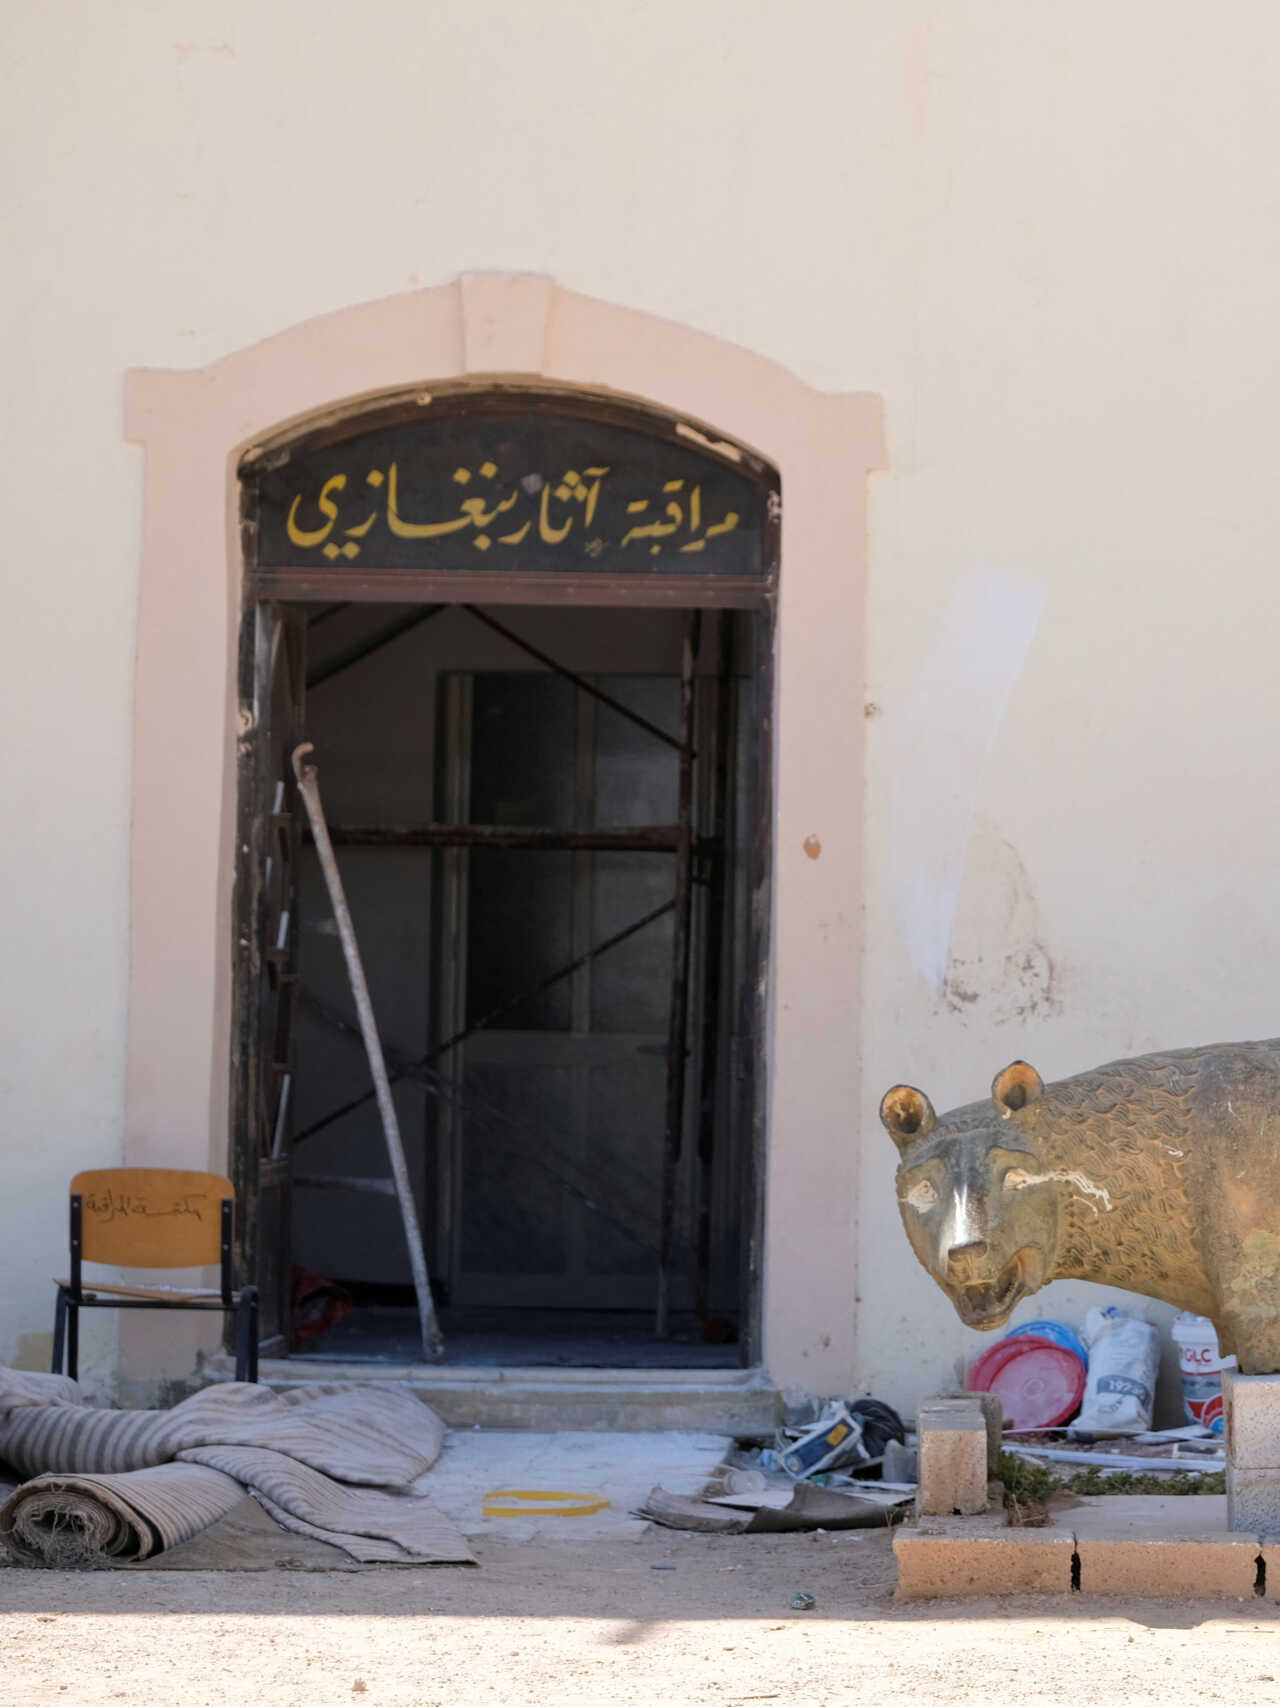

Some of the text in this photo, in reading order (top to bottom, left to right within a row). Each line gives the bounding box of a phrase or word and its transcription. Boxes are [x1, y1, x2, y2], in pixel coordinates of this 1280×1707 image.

[286, 460, 740, 560] مراقبة آثار بنغازي
